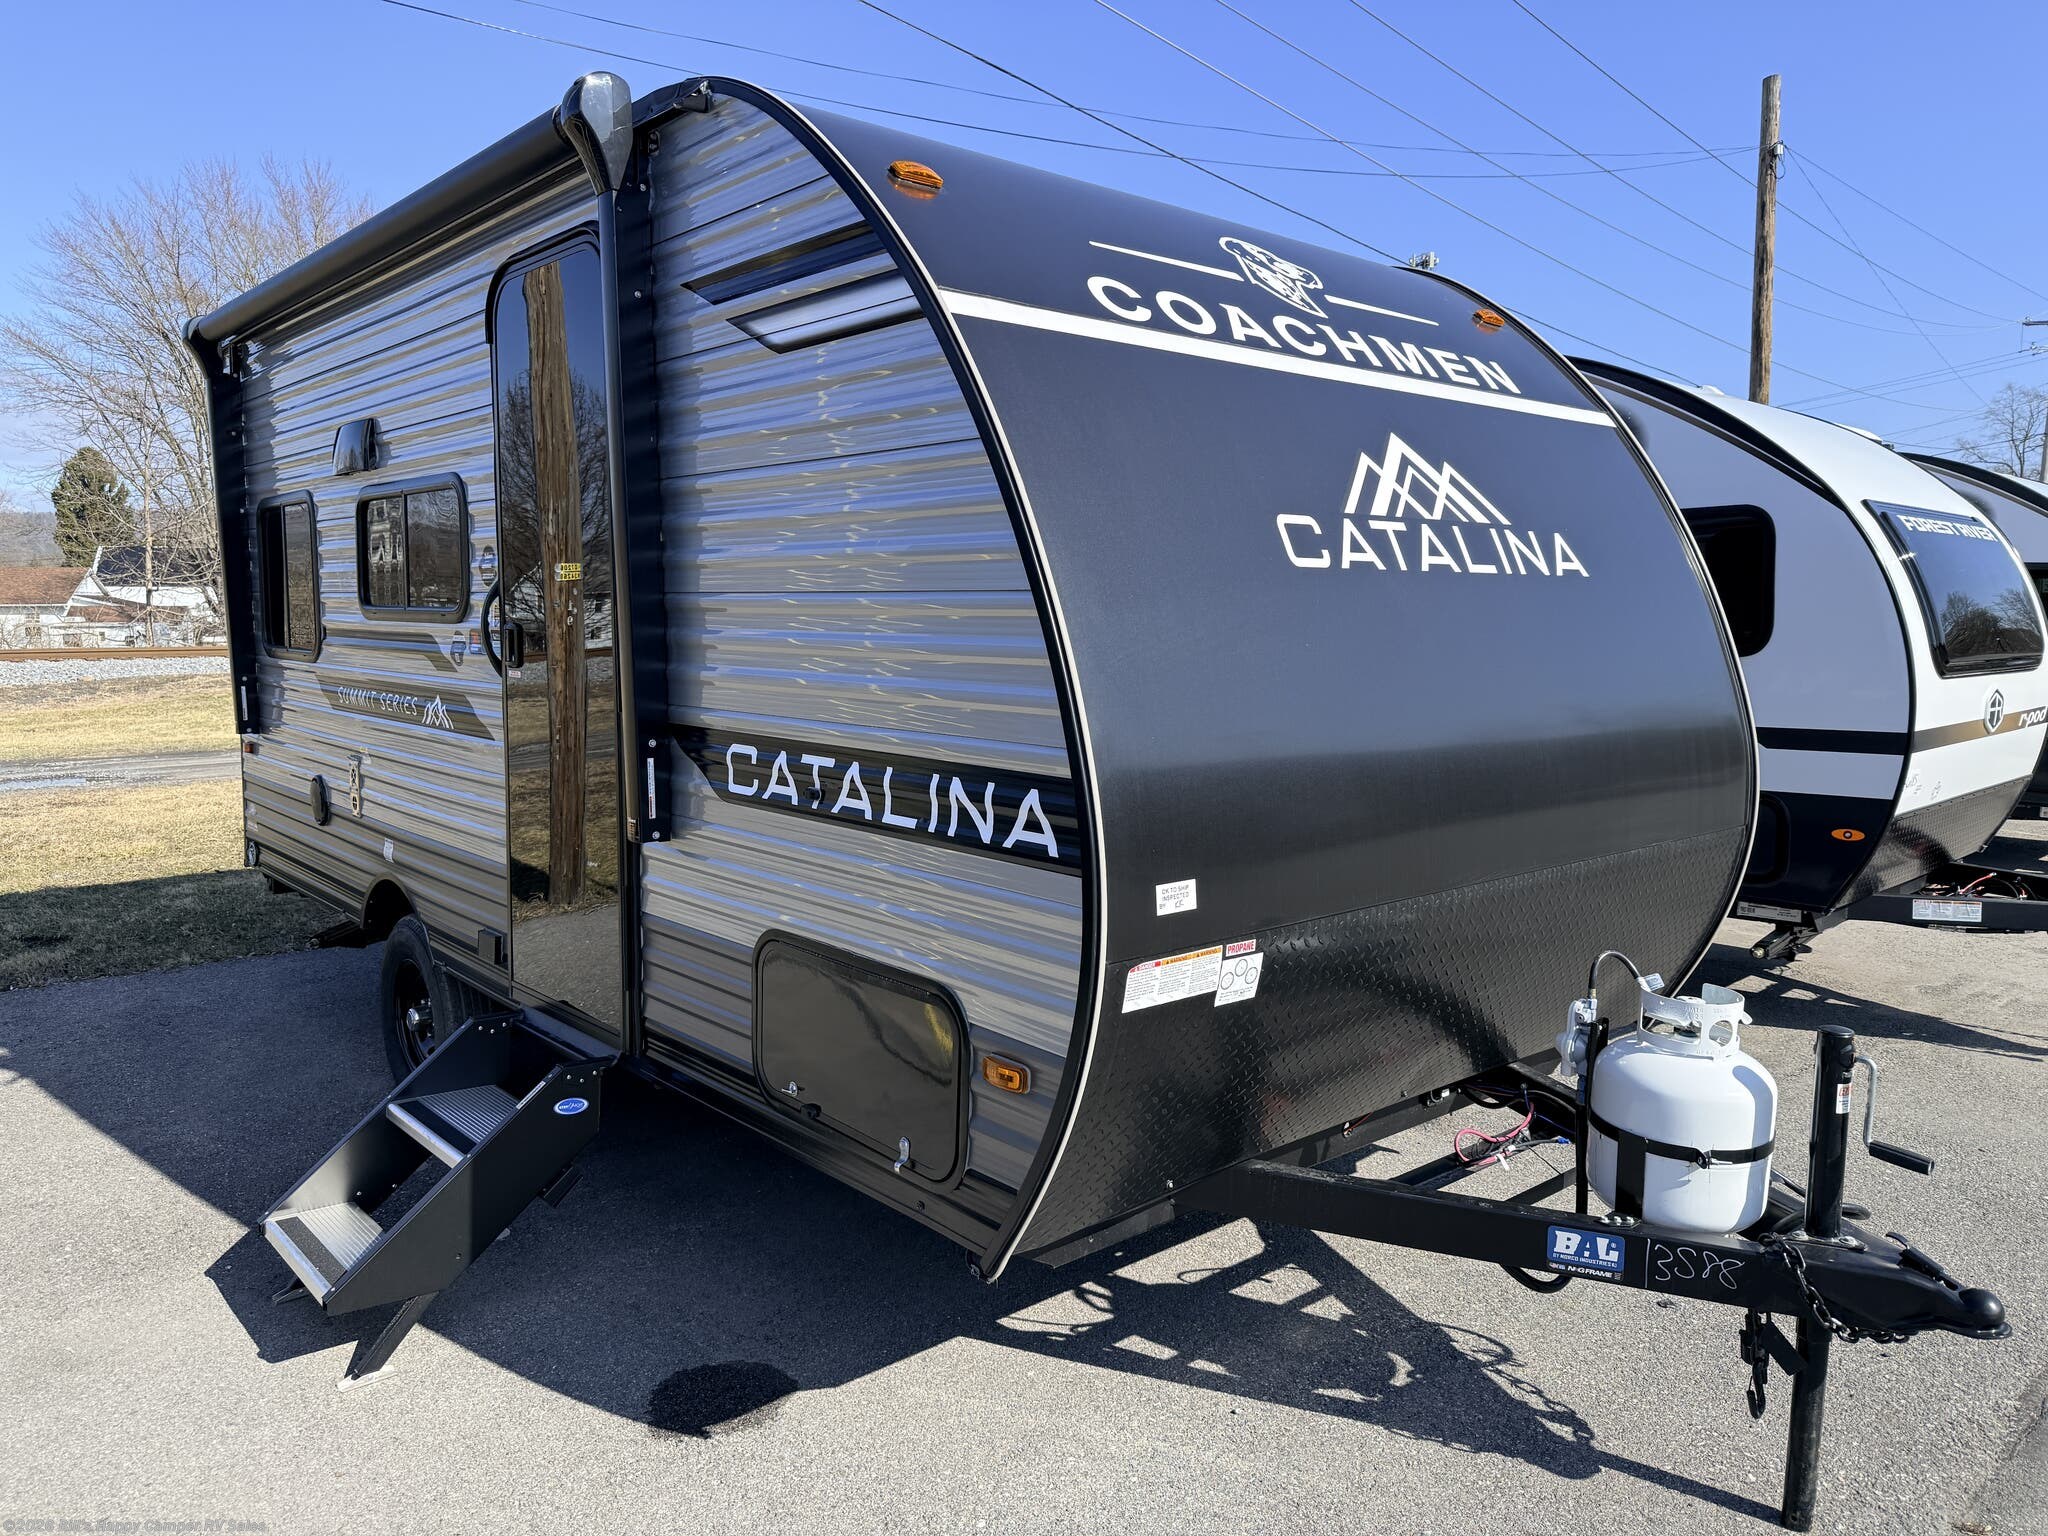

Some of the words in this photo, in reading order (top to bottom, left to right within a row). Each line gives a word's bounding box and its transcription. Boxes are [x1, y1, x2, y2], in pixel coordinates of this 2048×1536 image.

[1087, 276, 1521, 395] COACHMEN
[1896, 514, 1960, 536] FOREST
[1952, 522, 1999, 542] RIVER
[1276, 513, 1590, 578] CATALINA
[337, 686, 377, 709] SUMMIT
[379, 692, 418, 716] SERIES
[725, 743, 1059, 858] CATALINA
[1162, 891, 1189, 901] INSPECTED
[1227, 941, 1255, 954] PROPANE
[1580, 1257, 1612, 1267] INDUSTRIES
[1585, 1268, 1613, 1278] FRAME
